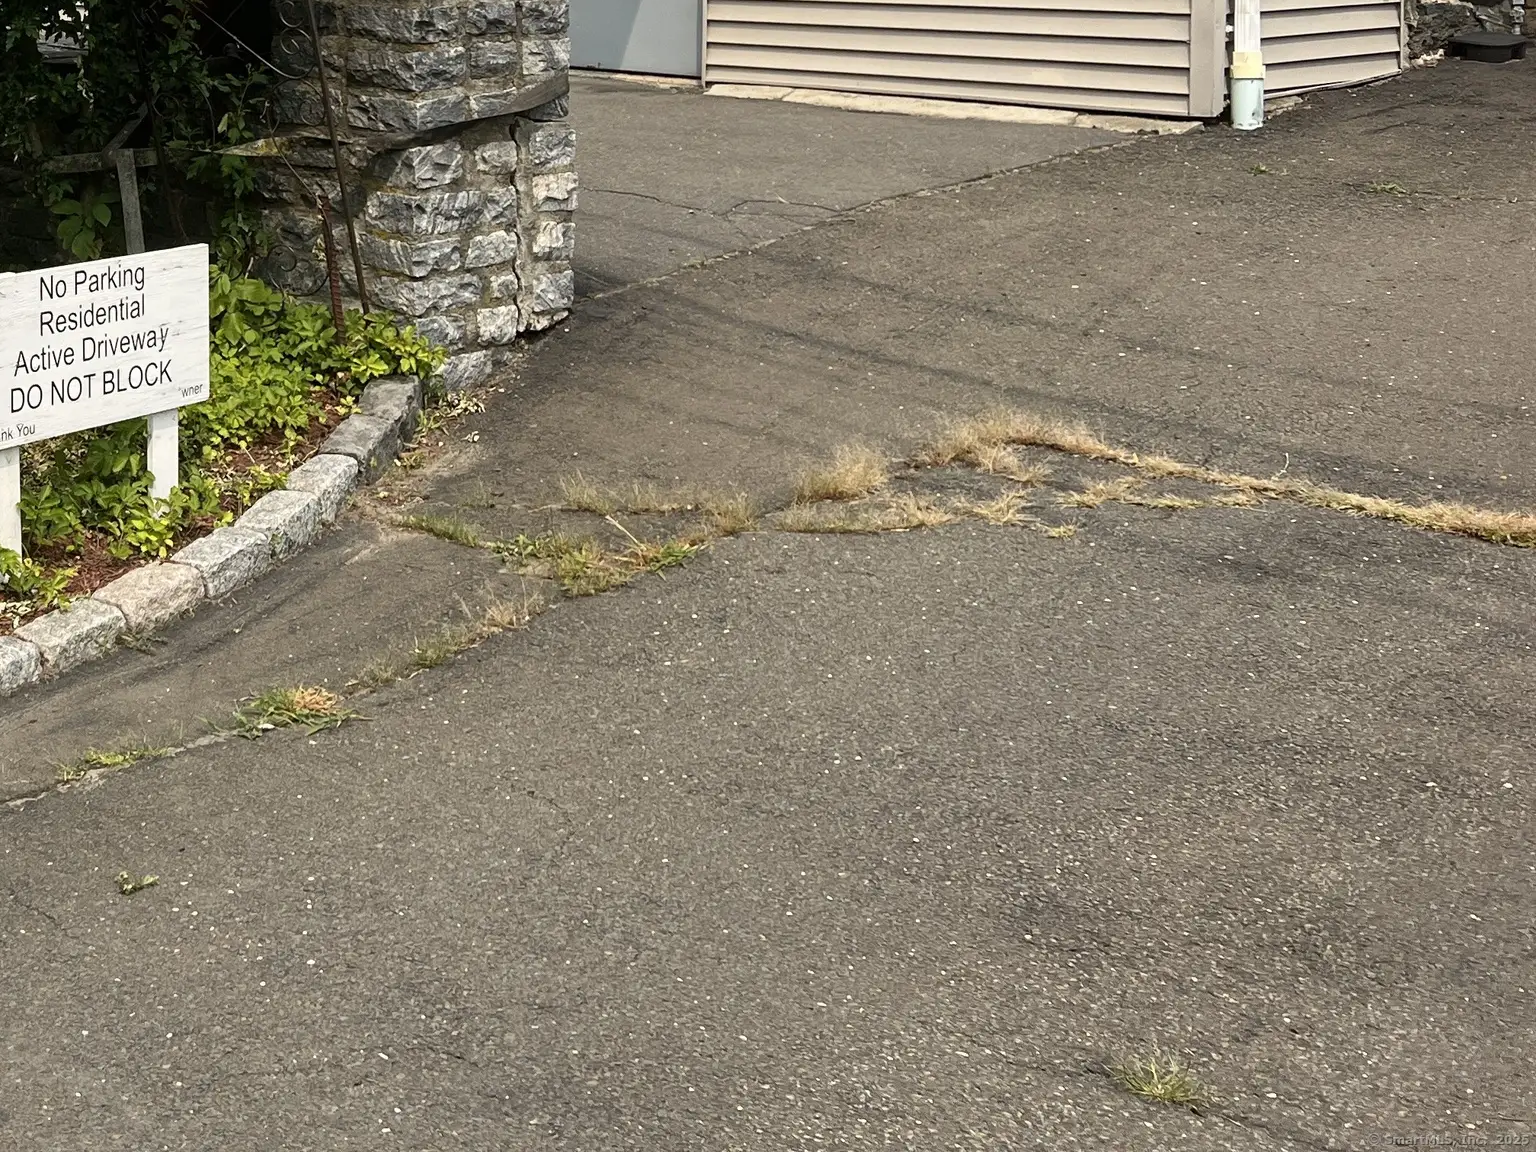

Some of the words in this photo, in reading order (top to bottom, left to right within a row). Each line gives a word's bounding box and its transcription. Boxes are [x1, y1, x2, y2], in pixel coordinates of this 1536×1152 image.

[39, 276, 66, 301] No
[74, 264, 145, 295] Parking
[39, 294, 145, 336] Residential
[14, 346, 75, 376] Active
[82, 326, 169, 362] Driveway
[11, 383, 42, 413] DO
[51, 373, 96, 406] NOT
[103, 359, 173, 395] BLOCK
[178, 384, 203, 398] wner
[16, 423, 36, 438] You
